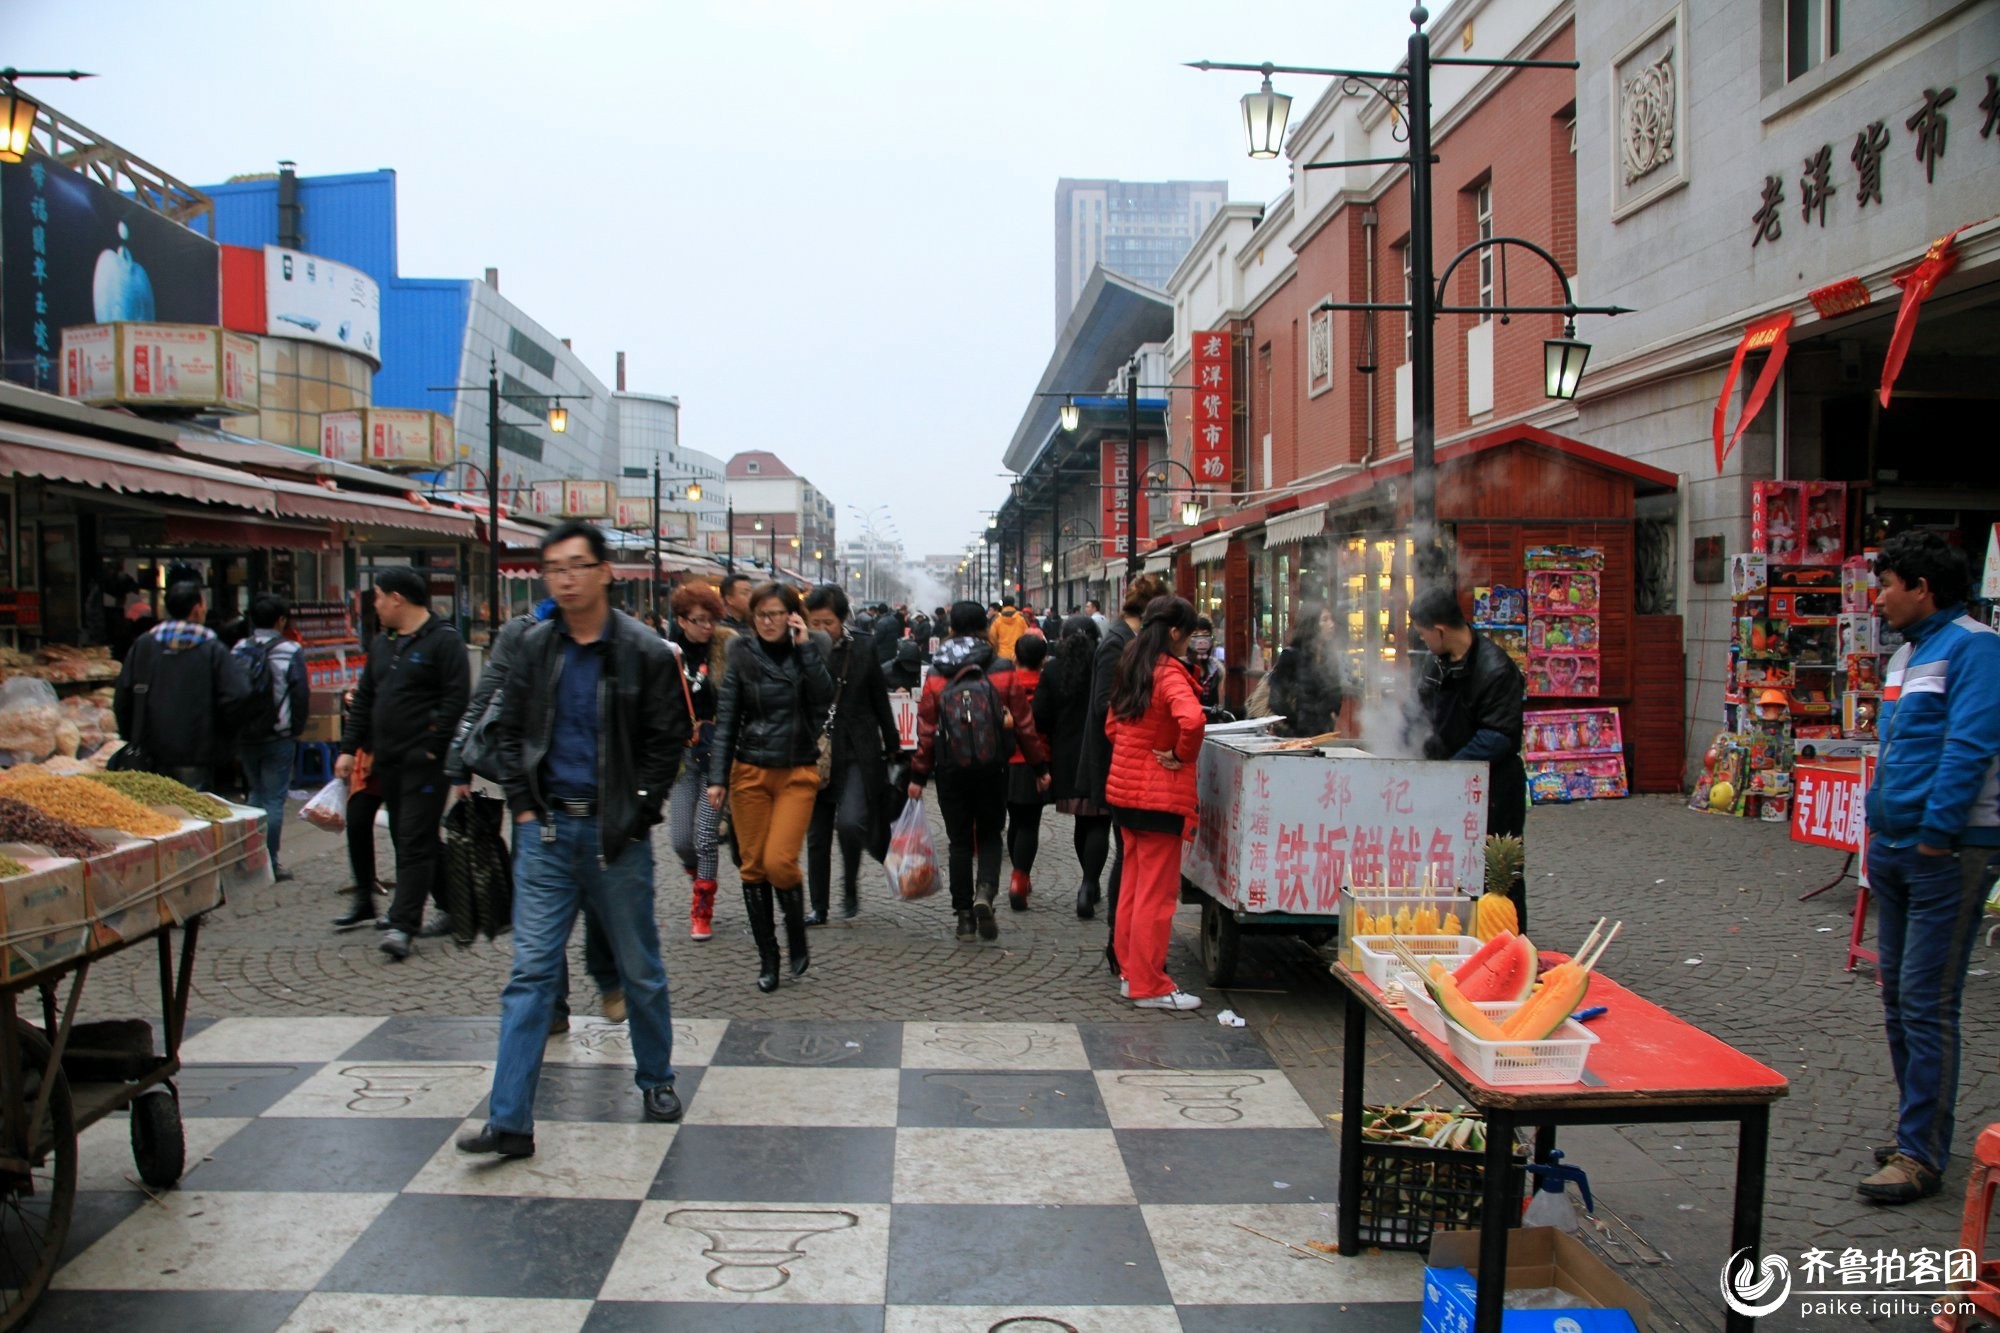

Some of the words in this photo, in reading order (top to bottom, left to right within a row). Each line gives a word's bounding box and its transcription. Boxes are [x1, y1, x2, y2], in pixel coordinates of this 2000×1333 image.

[1202, 335, 1224, 478] 老洋货市场
[1317, 769, 1414, 822] 郑记
[1275, 823, 1454, 912] 铁板鲜鱿鱼
